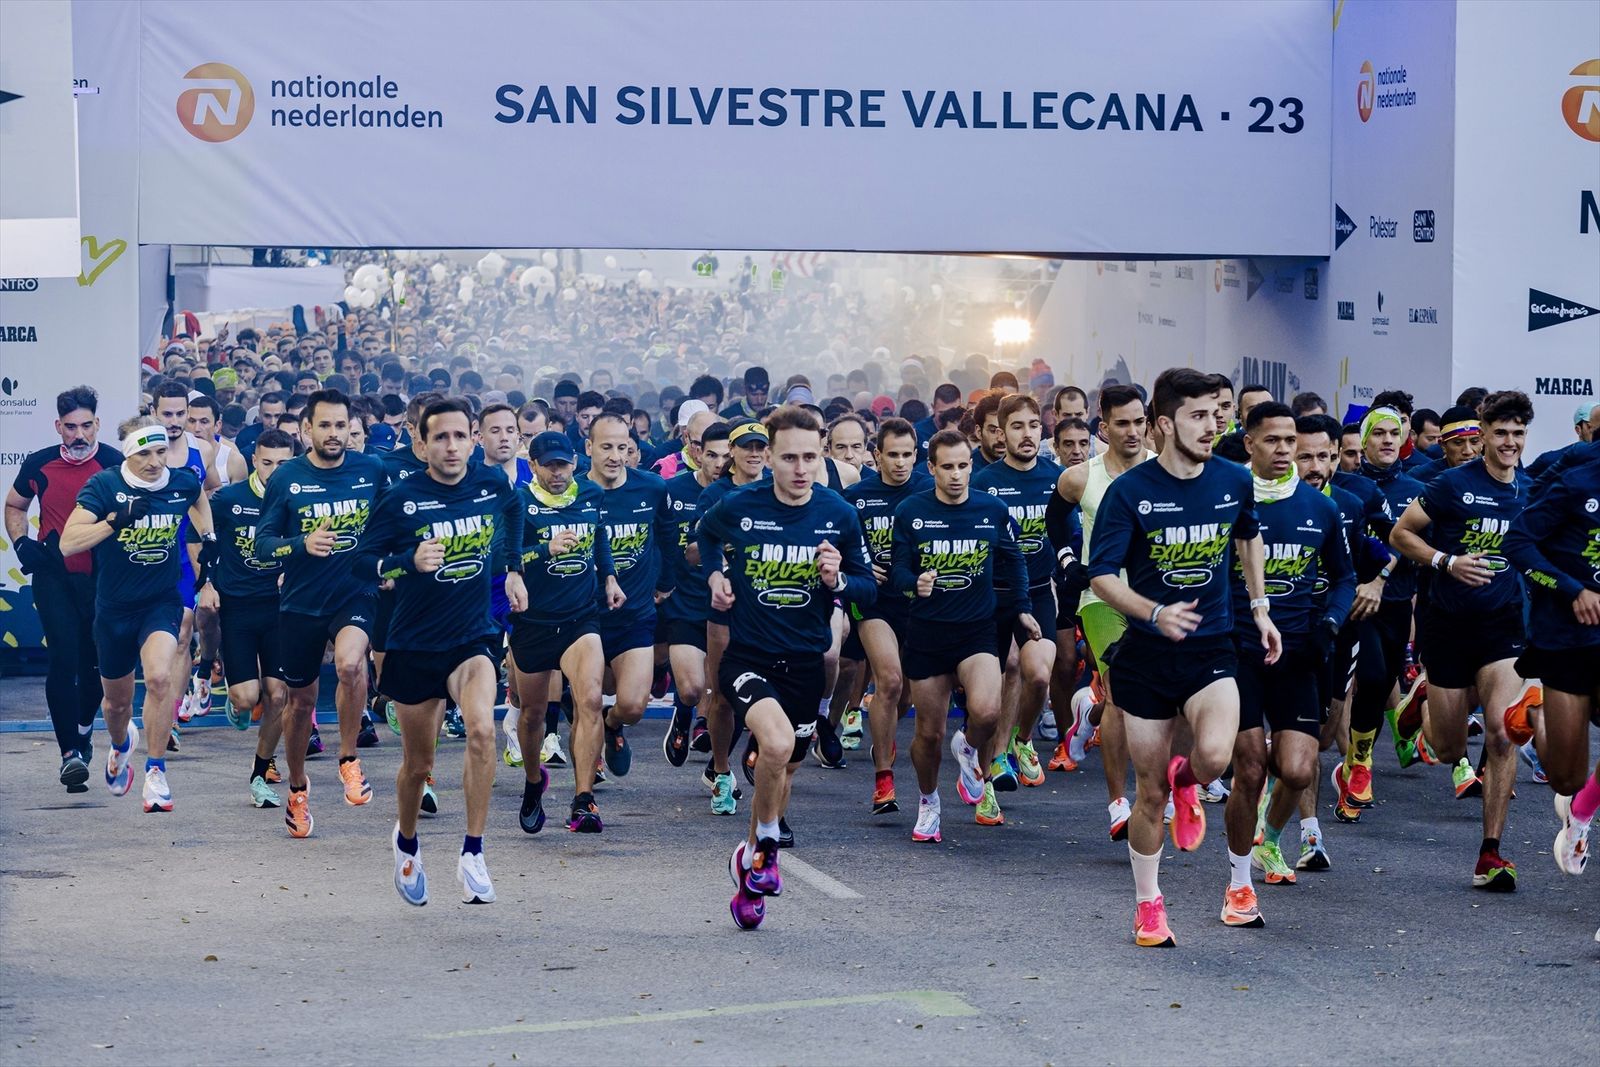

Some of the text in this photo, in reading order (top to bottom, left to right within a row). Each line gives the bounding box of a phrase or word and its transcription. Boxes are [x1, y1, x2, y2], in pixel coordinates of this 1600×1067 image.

[1378, 65, 1407, 85] nationale
[270, 76, 398, 98] nationale
[1377, 88, 1417, 108] nederlanden
[270, 104, 444, 127] nederlanden
[494, 84, 597, 125] SAN
[615, 86, 887, 128] SILVESTRE
[902, 90, 1204, 132] VALLECANA
[1248, 97, 1306, 135] 23
[1369, 215, 1399, 238] Polestar
[1536, 377, 1593, 396] MARCA
[1, 450, 33, 465] ESPA
[313, 499, 358, 519] NO HAY
[151, 514, 174, 528] HAY
[432, 515, 482, 541] NO HAY
[873, 516, 890, 531] NO
[1481, 518, 1499, 534] NO
[614, 524, 638, 539] HAY
[1165, 523, 1219, 545] NO HAY
[1460, 530, 1504, 548] EXCU
[762, 543, 784, 564] NO
[932, 540, 978, 555] NO HAY
[1149, 534, 1230, 564] EXCUSAS
[1273, 543, 1302, 561] HAY
[920, 549, 989, 570] EXCUSAS
[744, 559, 822, 581] EXCUSA
